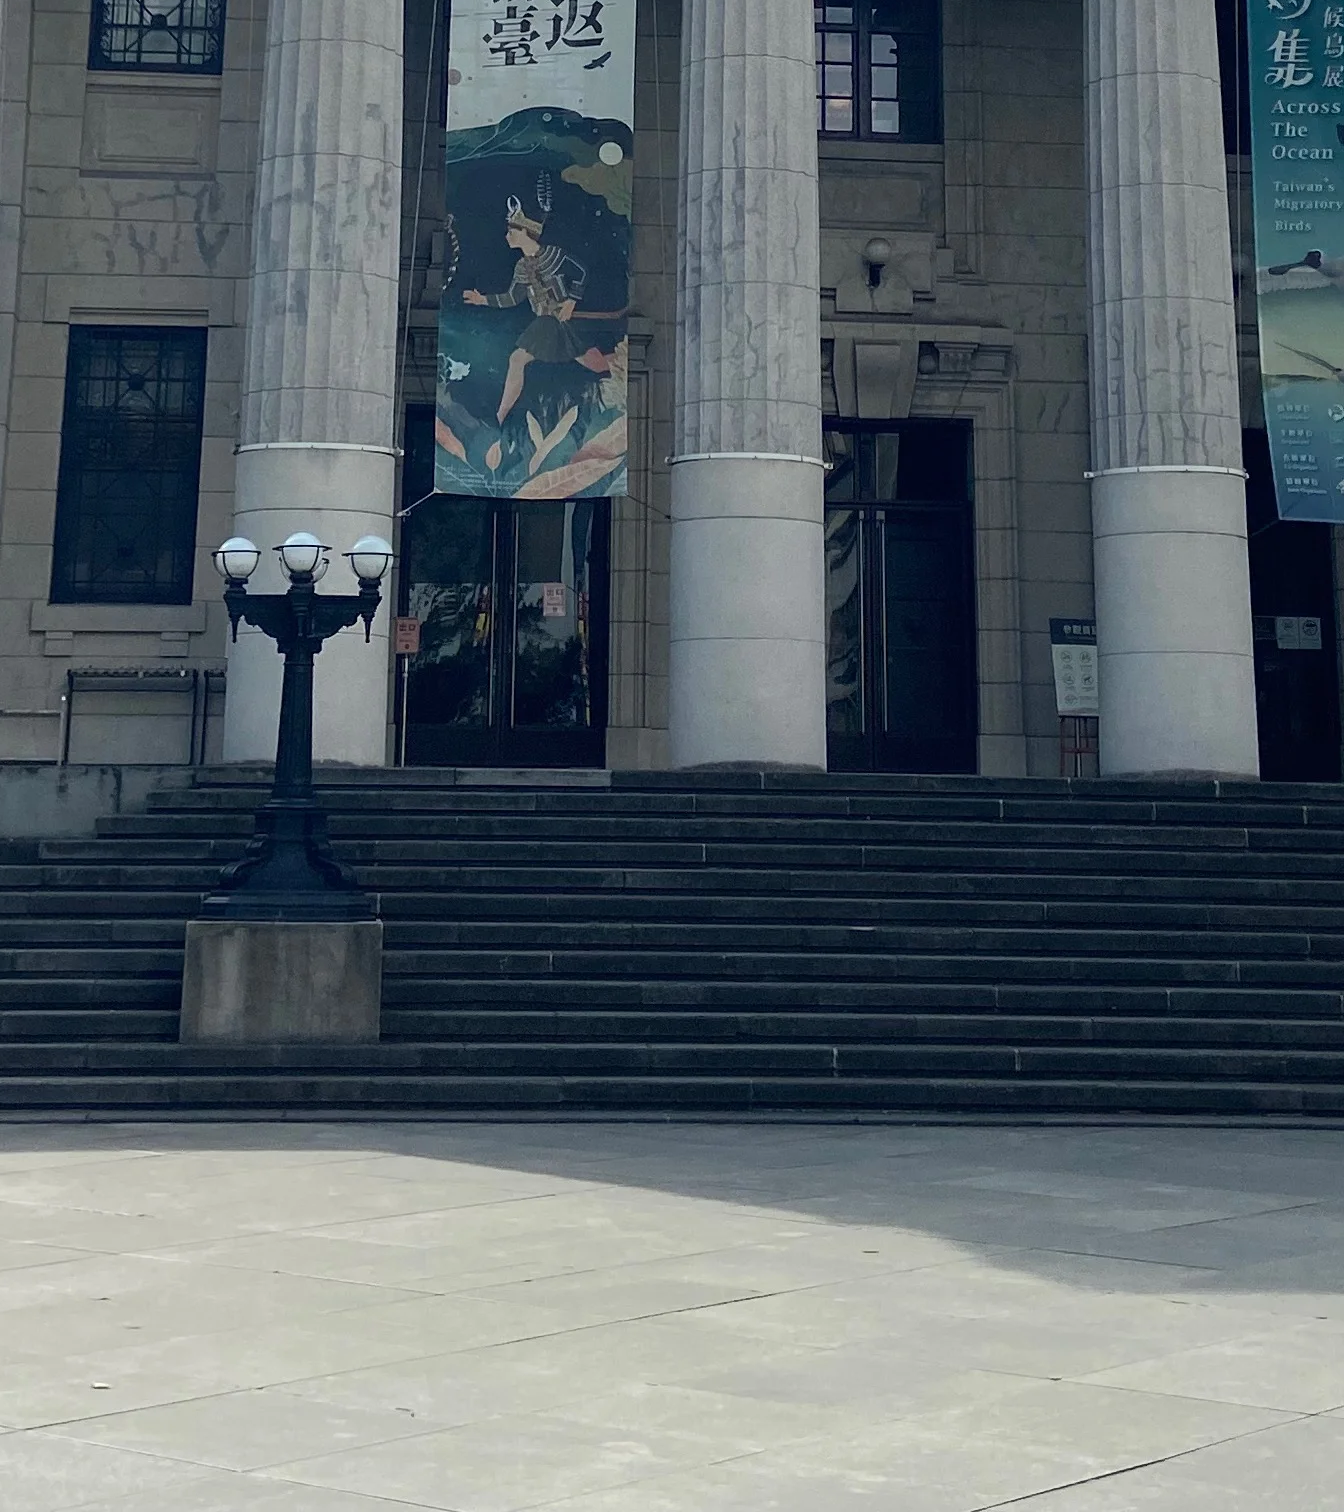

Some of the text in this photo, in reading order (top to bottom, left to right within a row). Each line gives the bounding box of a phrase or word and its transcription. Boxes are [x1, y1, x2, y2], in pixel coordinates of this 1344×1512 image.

[1271, 99, 1341, 115] Across
[1271, 122, 1308, 138] The
[1272, 144, 1334, 160] Ocean
[1273, 198, 1344, 212] Migratory
[1274, 219, 1312, 232] Birds
